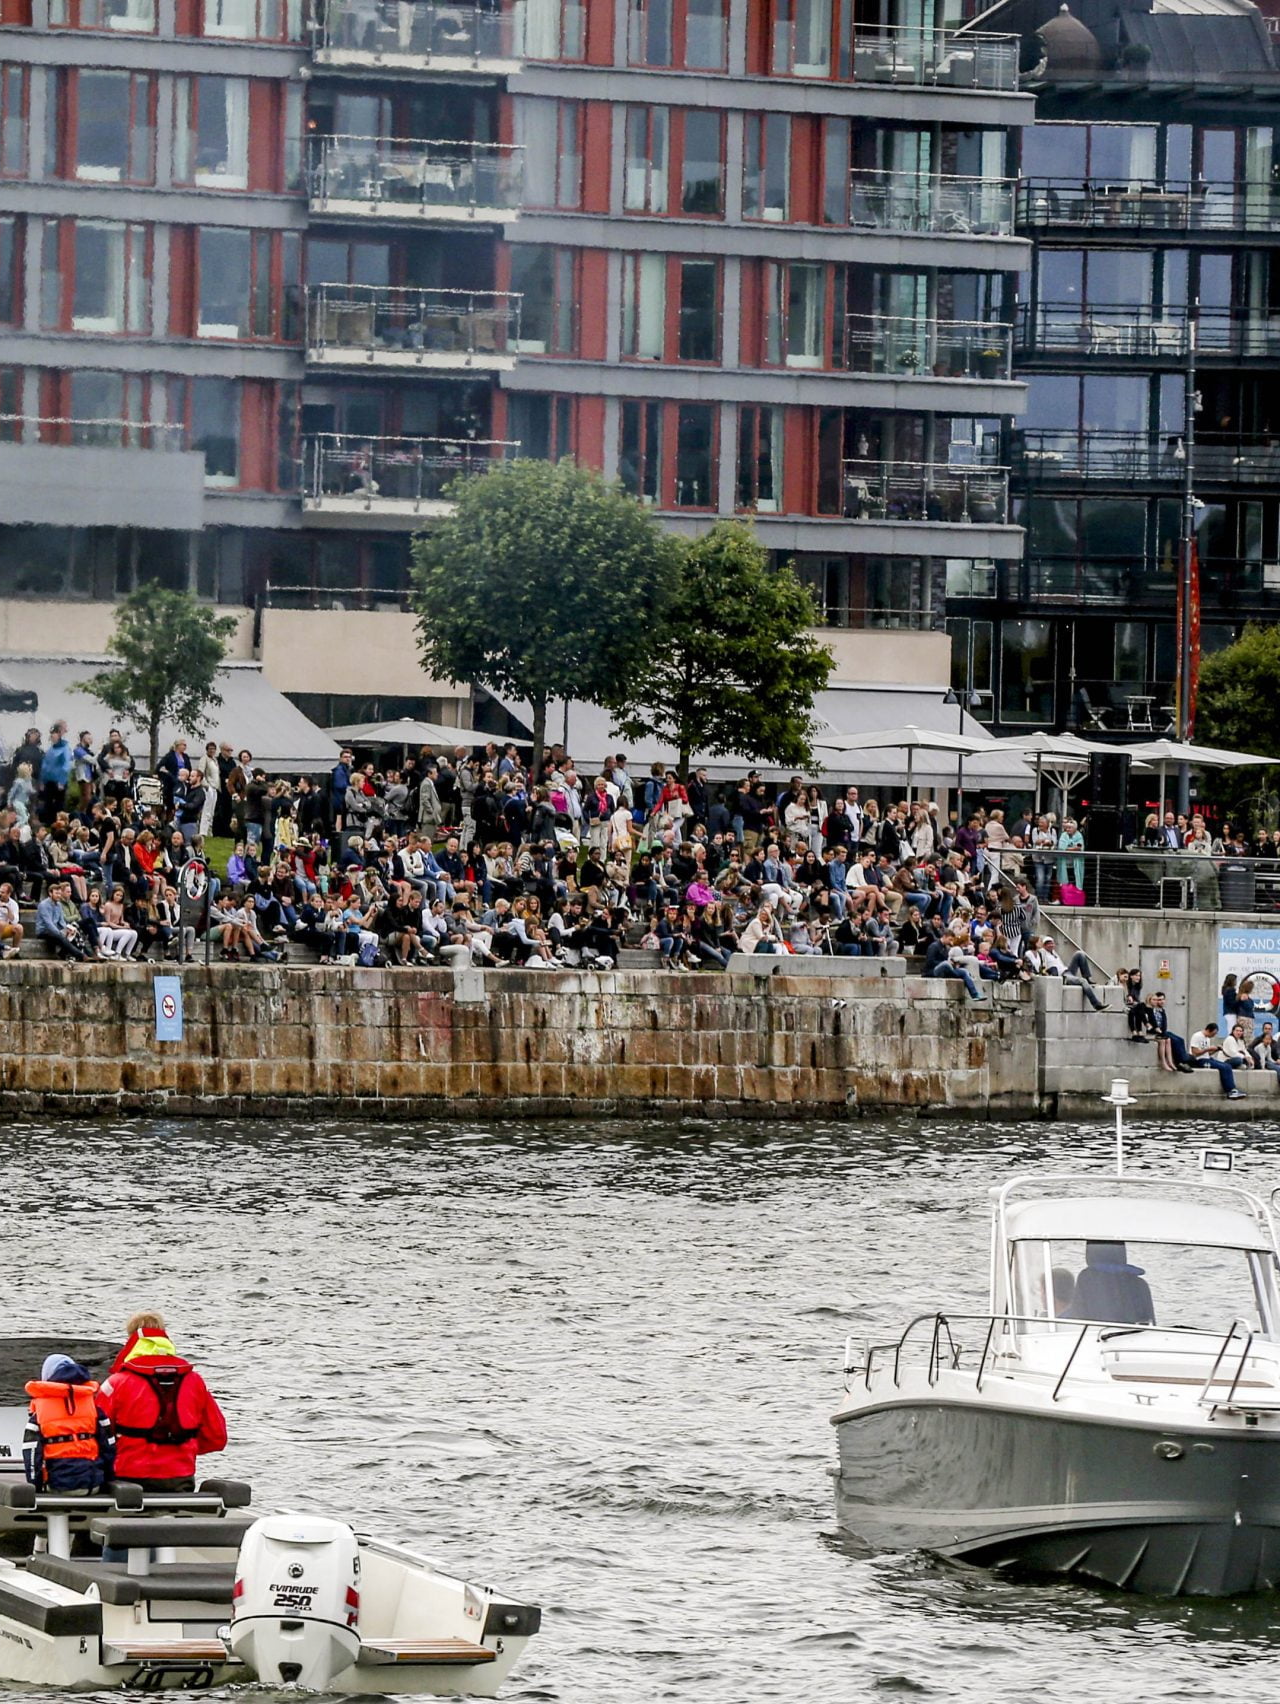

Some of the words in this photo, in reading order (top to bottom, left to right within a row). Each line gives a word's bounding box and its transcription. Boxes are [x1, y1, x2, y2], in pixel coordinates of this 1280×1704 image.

[1221, 938, 1247, 950] KISS
[1250, 939, 1275, 950] AND
[270, 1584, 319, 1594] EVINRUDE
[274, 1594, 312, 1608] 250
